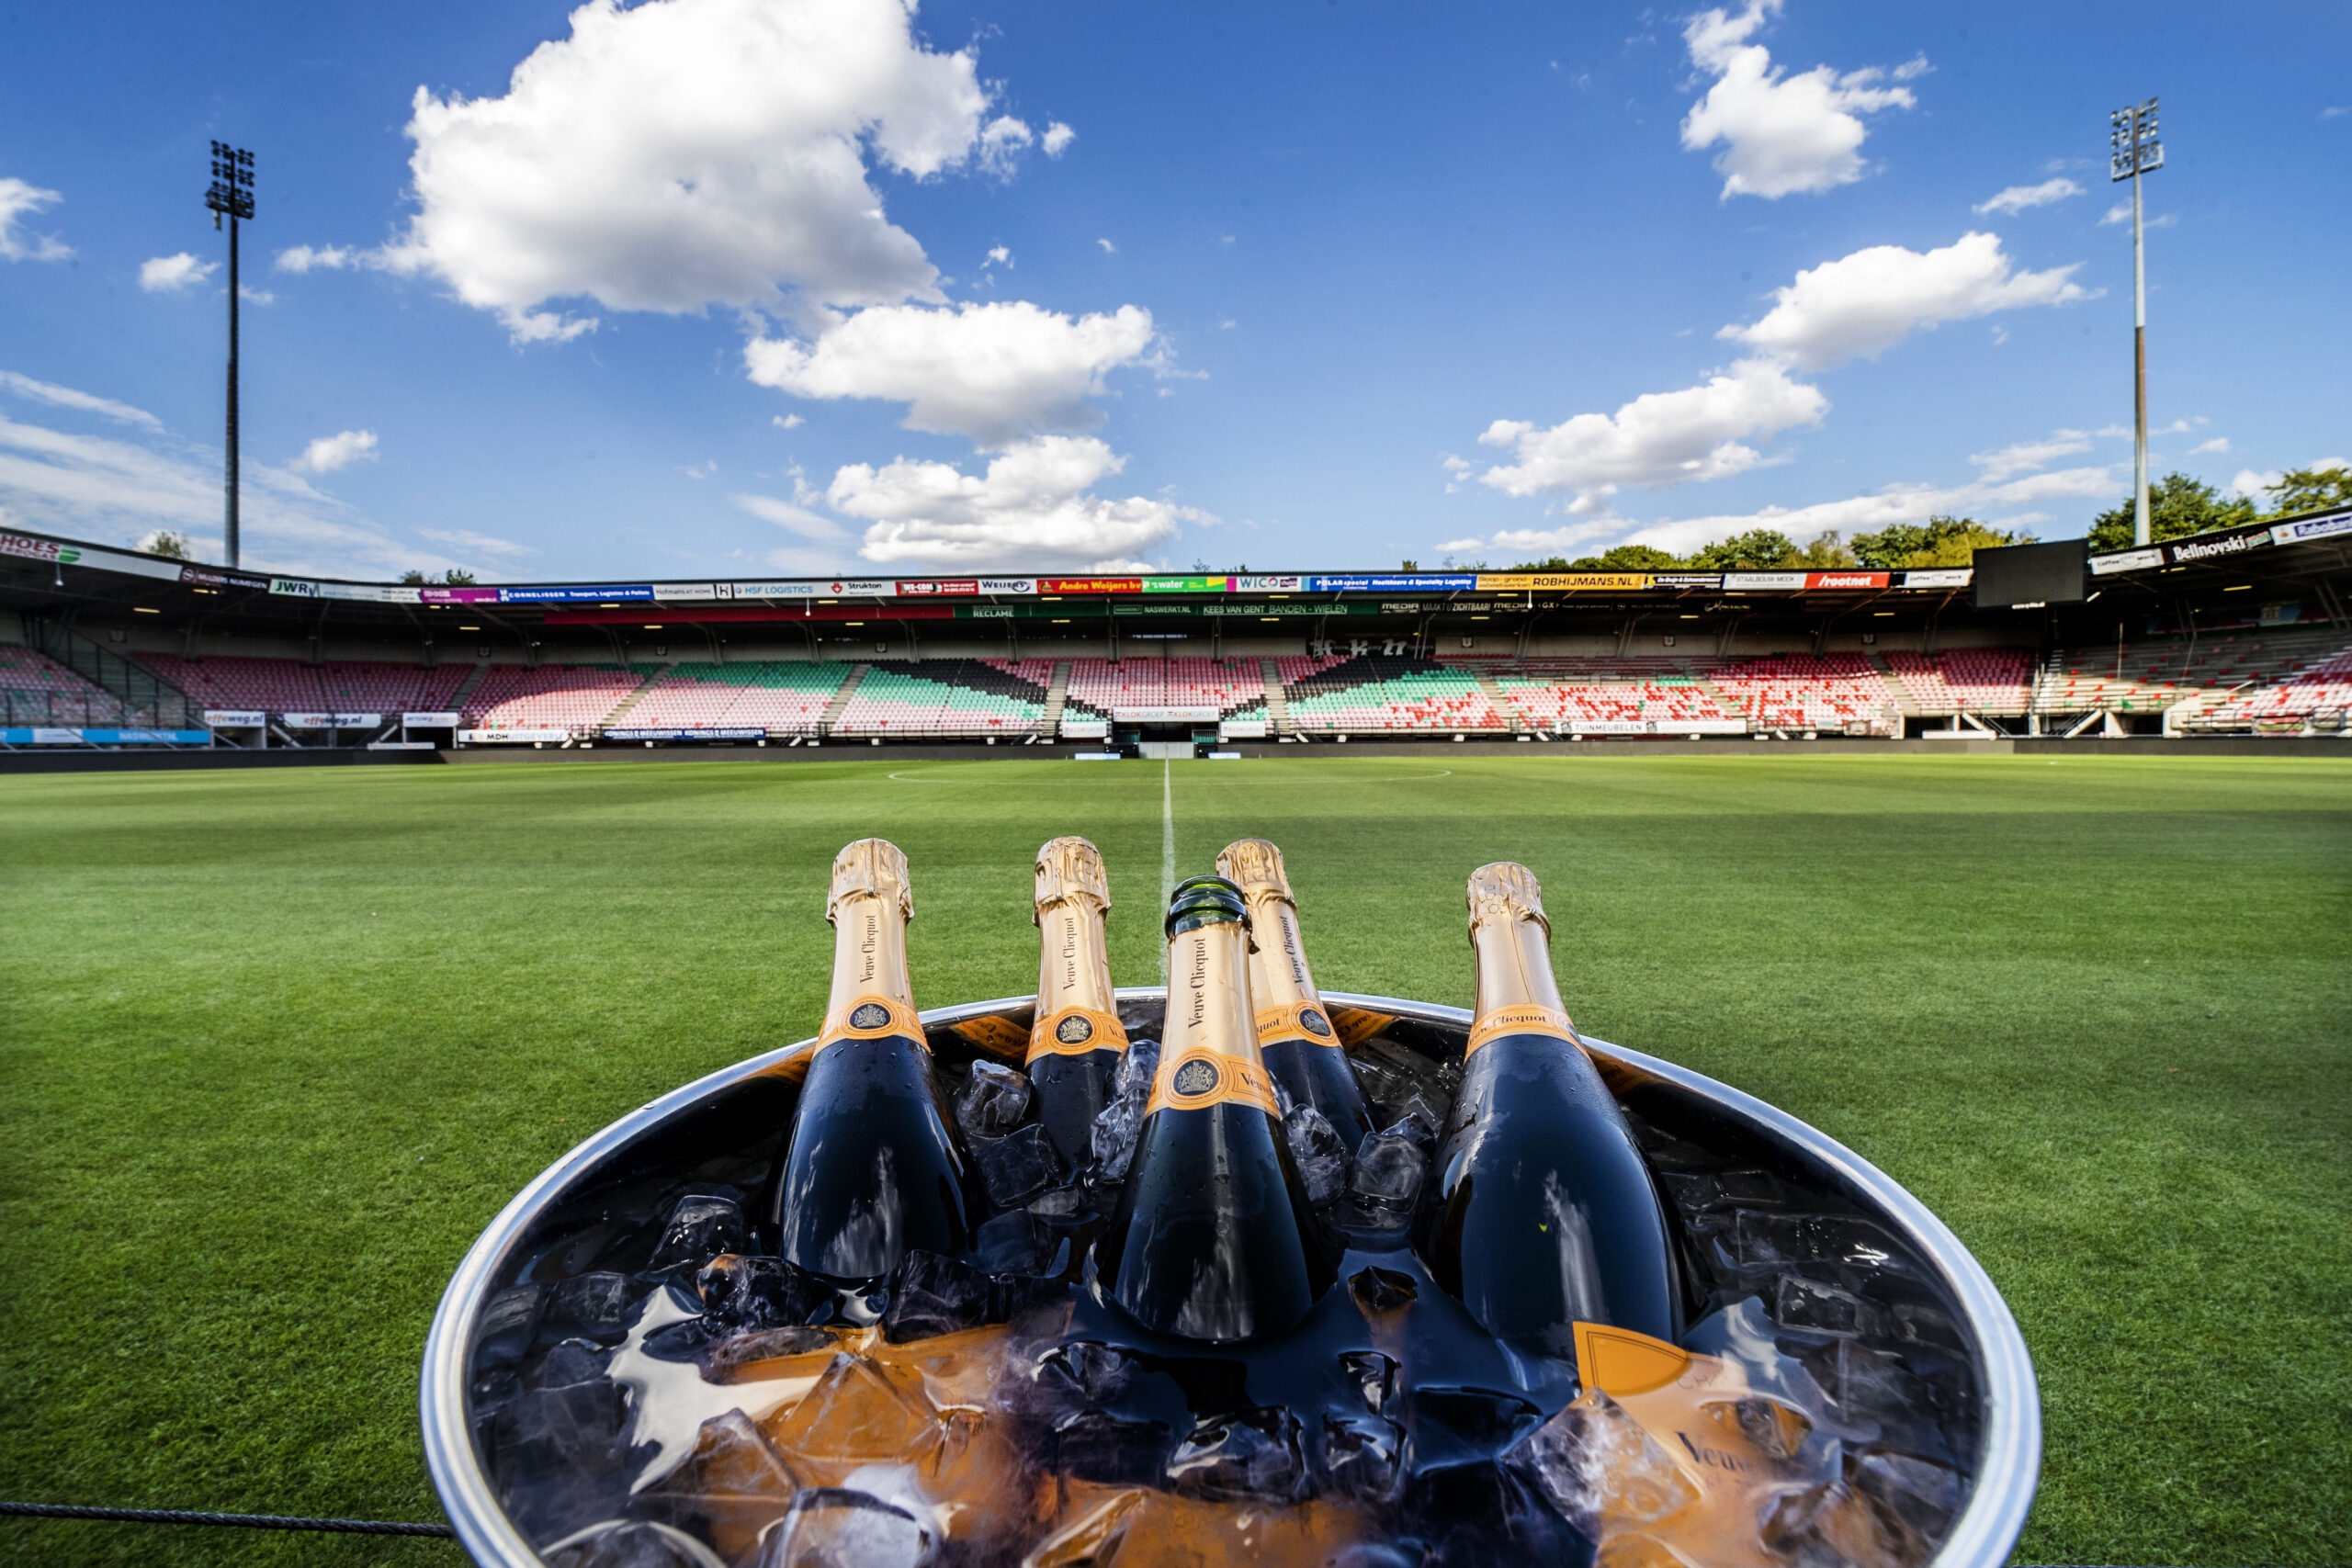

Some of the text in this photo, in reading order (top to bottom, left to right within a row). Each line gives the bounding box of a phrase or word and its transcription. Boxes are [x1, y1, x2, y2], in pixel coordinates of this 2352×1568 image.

[2173, 535, 2246, 561] Bellnovski
[1091, 580, 1127, 592] Weijers
[1129, 580, 1142, 589] bv
[1240, 577, 1278, 588] WICO
[745, 585, 814, 594] HSF LOGISTICS
[1204, 605, 1225, 614] KEES
[1226, 604, 1241, 614] VAN
[1243, 604, 1264, 614] GENT
[1269, 604, 1306, 614] BANDEN
[1315, 604, 1348, 614] WIELEN
[1422, 603, 1445, 612] MAAKT
[207, 715, 264, 725] effeweg.nl
[860, 915, 879, 984] Veuve Clicquot
[1063, 918, 1078, 992] Veuve Clicquot
[1279, 916, 1305, 984] Veuve Clicquot
[1188, 938, 1209, 1029] Veuve Clicquot
[1492, 1015, 1547, 1027] Clicquot
